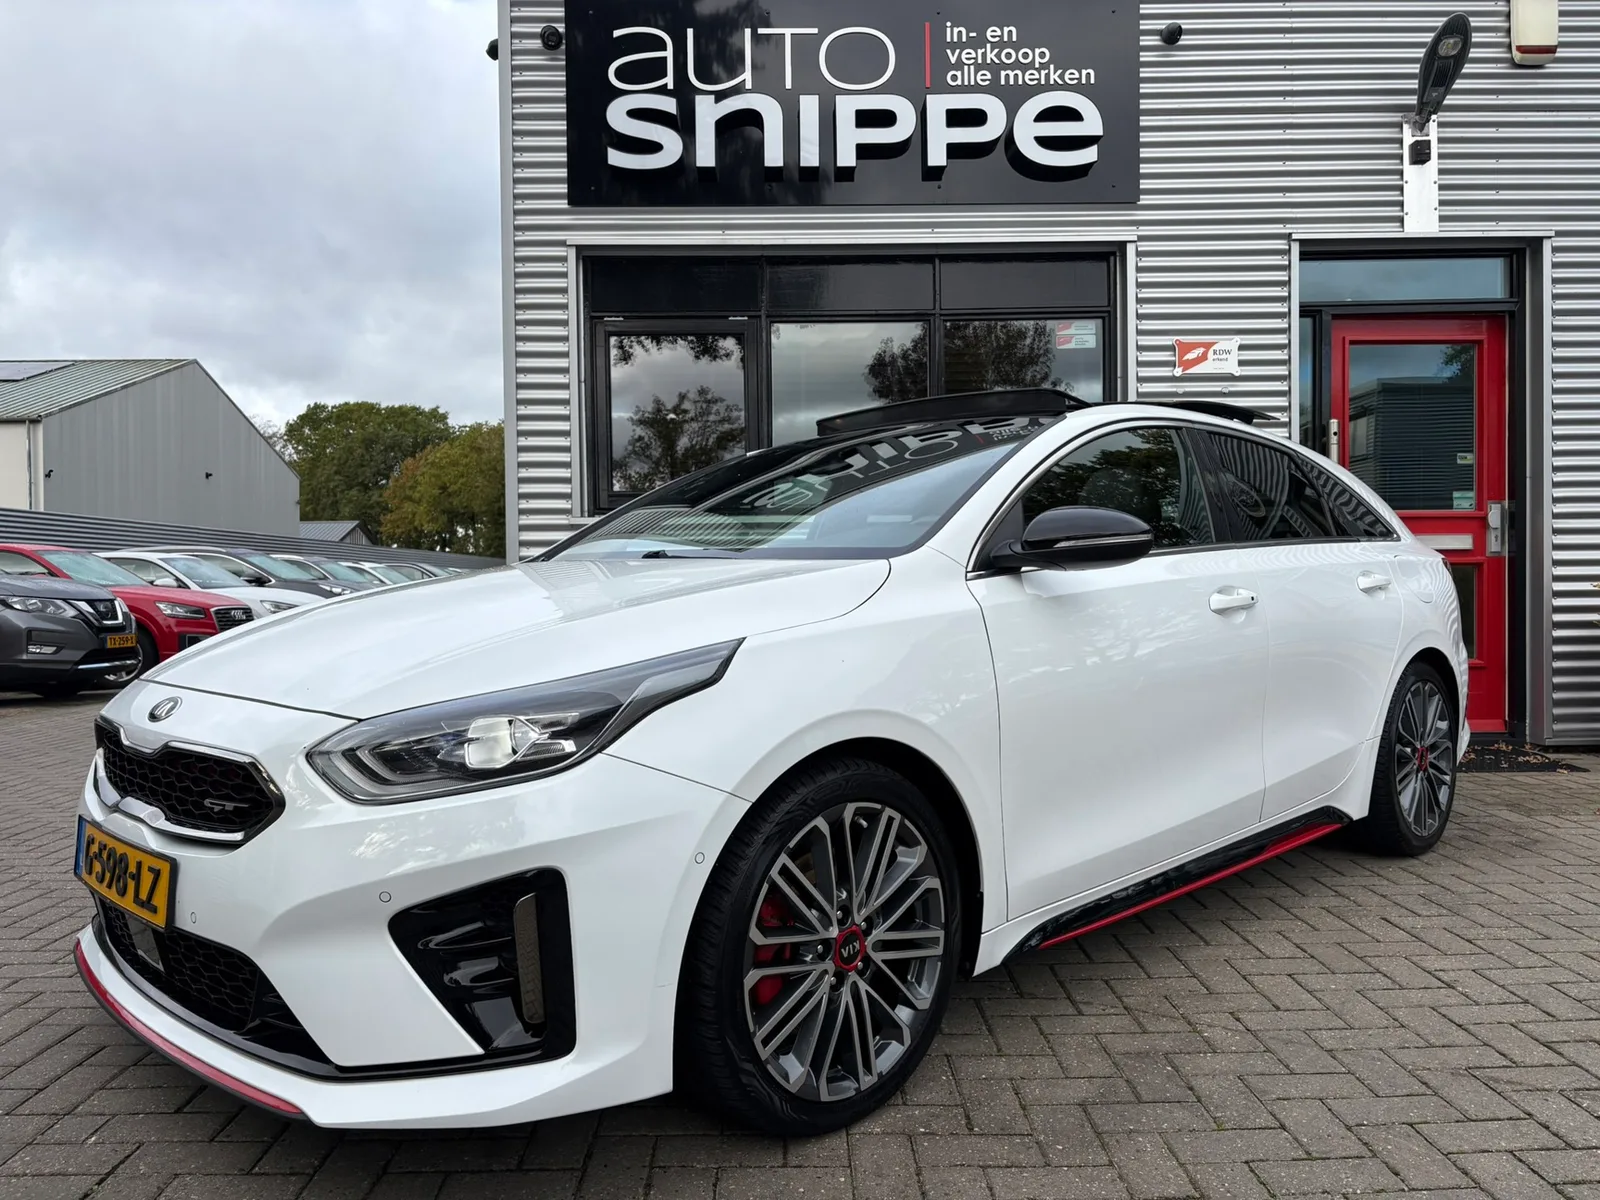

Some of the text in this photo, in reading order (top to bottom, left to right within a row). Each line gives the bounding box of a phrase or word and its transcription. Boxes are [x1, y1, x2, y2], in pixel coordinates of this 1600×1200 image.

[946, 21, 1017, 42] in- en
[946, 43, 1050, 68] verkoop
[946, 64, 1095, 86] alle merken
[841, 940, 860, 958] KIA
